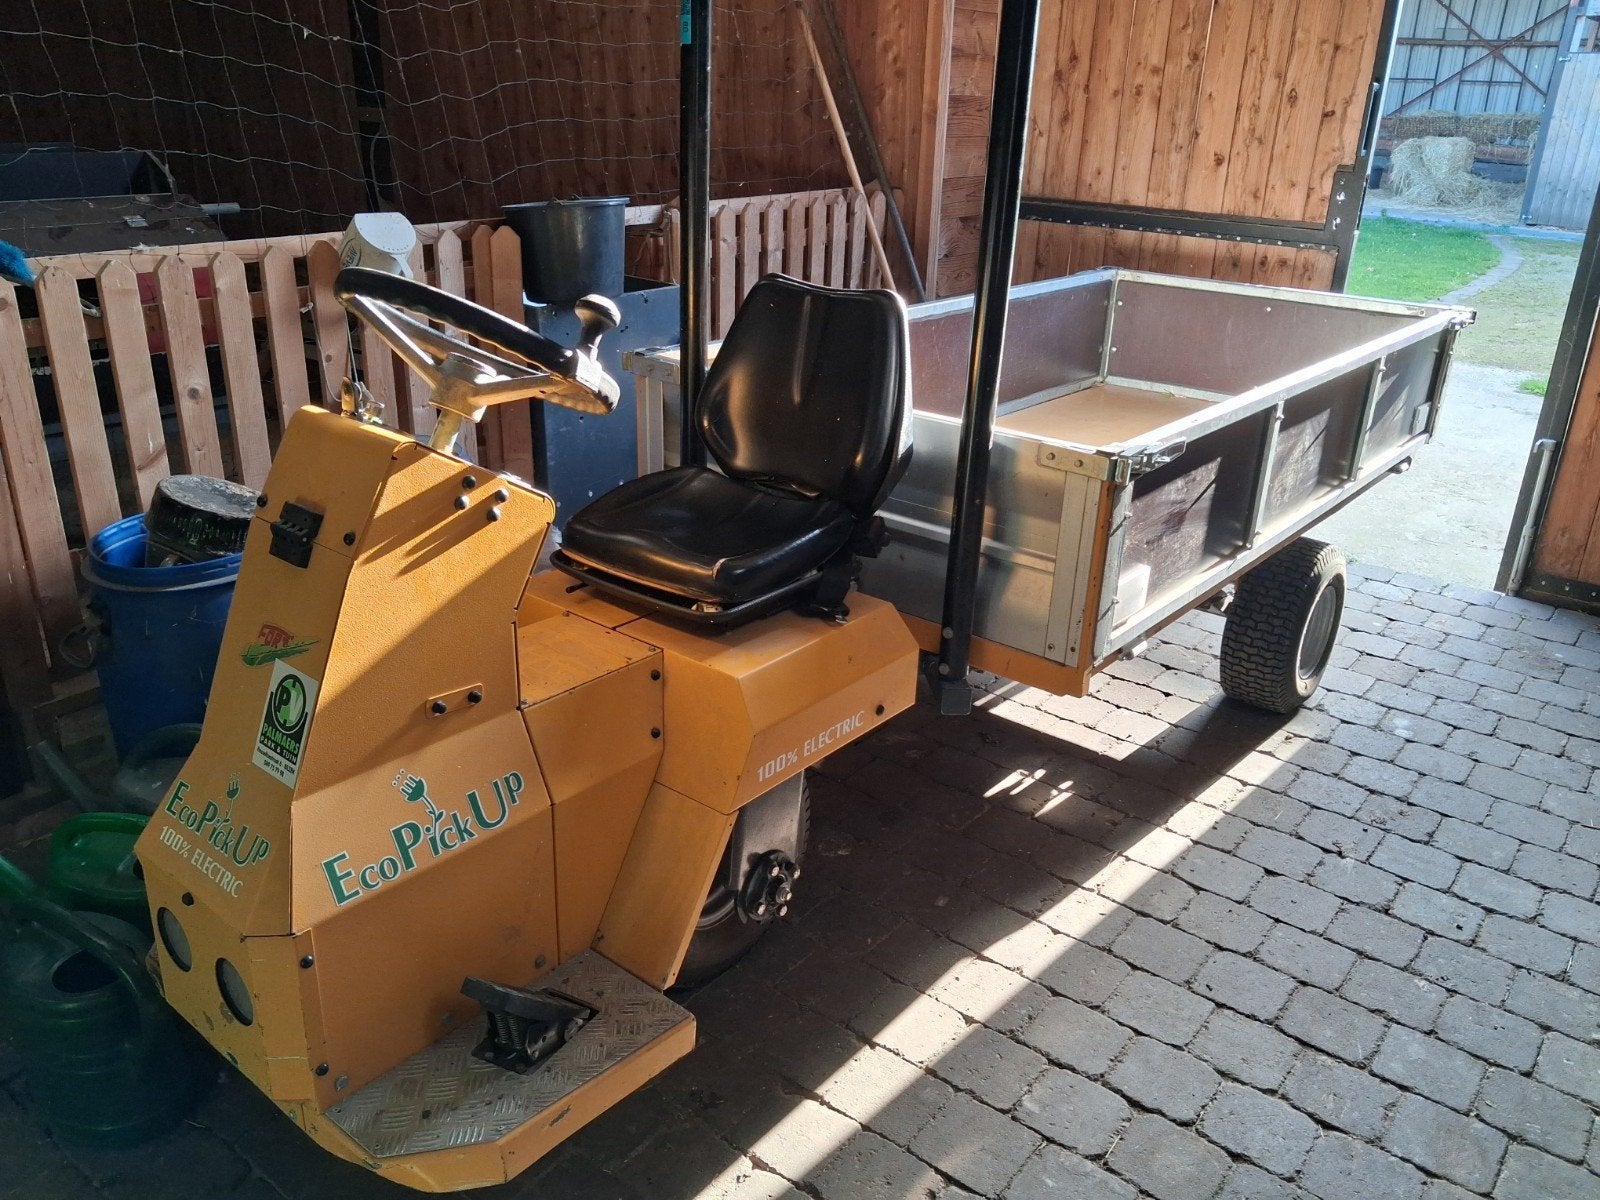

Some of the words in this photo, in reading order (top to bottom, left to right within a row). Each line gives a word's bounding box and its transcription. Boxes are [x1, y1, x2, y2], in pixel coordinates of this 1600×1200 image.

[260, 735, 275, 750] PARK
[282, 749, 298, 764] TUIN
[263, 724, 300, 755] PALMAERS
[757, 748, 798, 782] 100%
[803, 710, 865, 757] ELECTRIC
[160, 825, 192, 858] 100%
[190, 848, 244, 898] ELECTRIC
